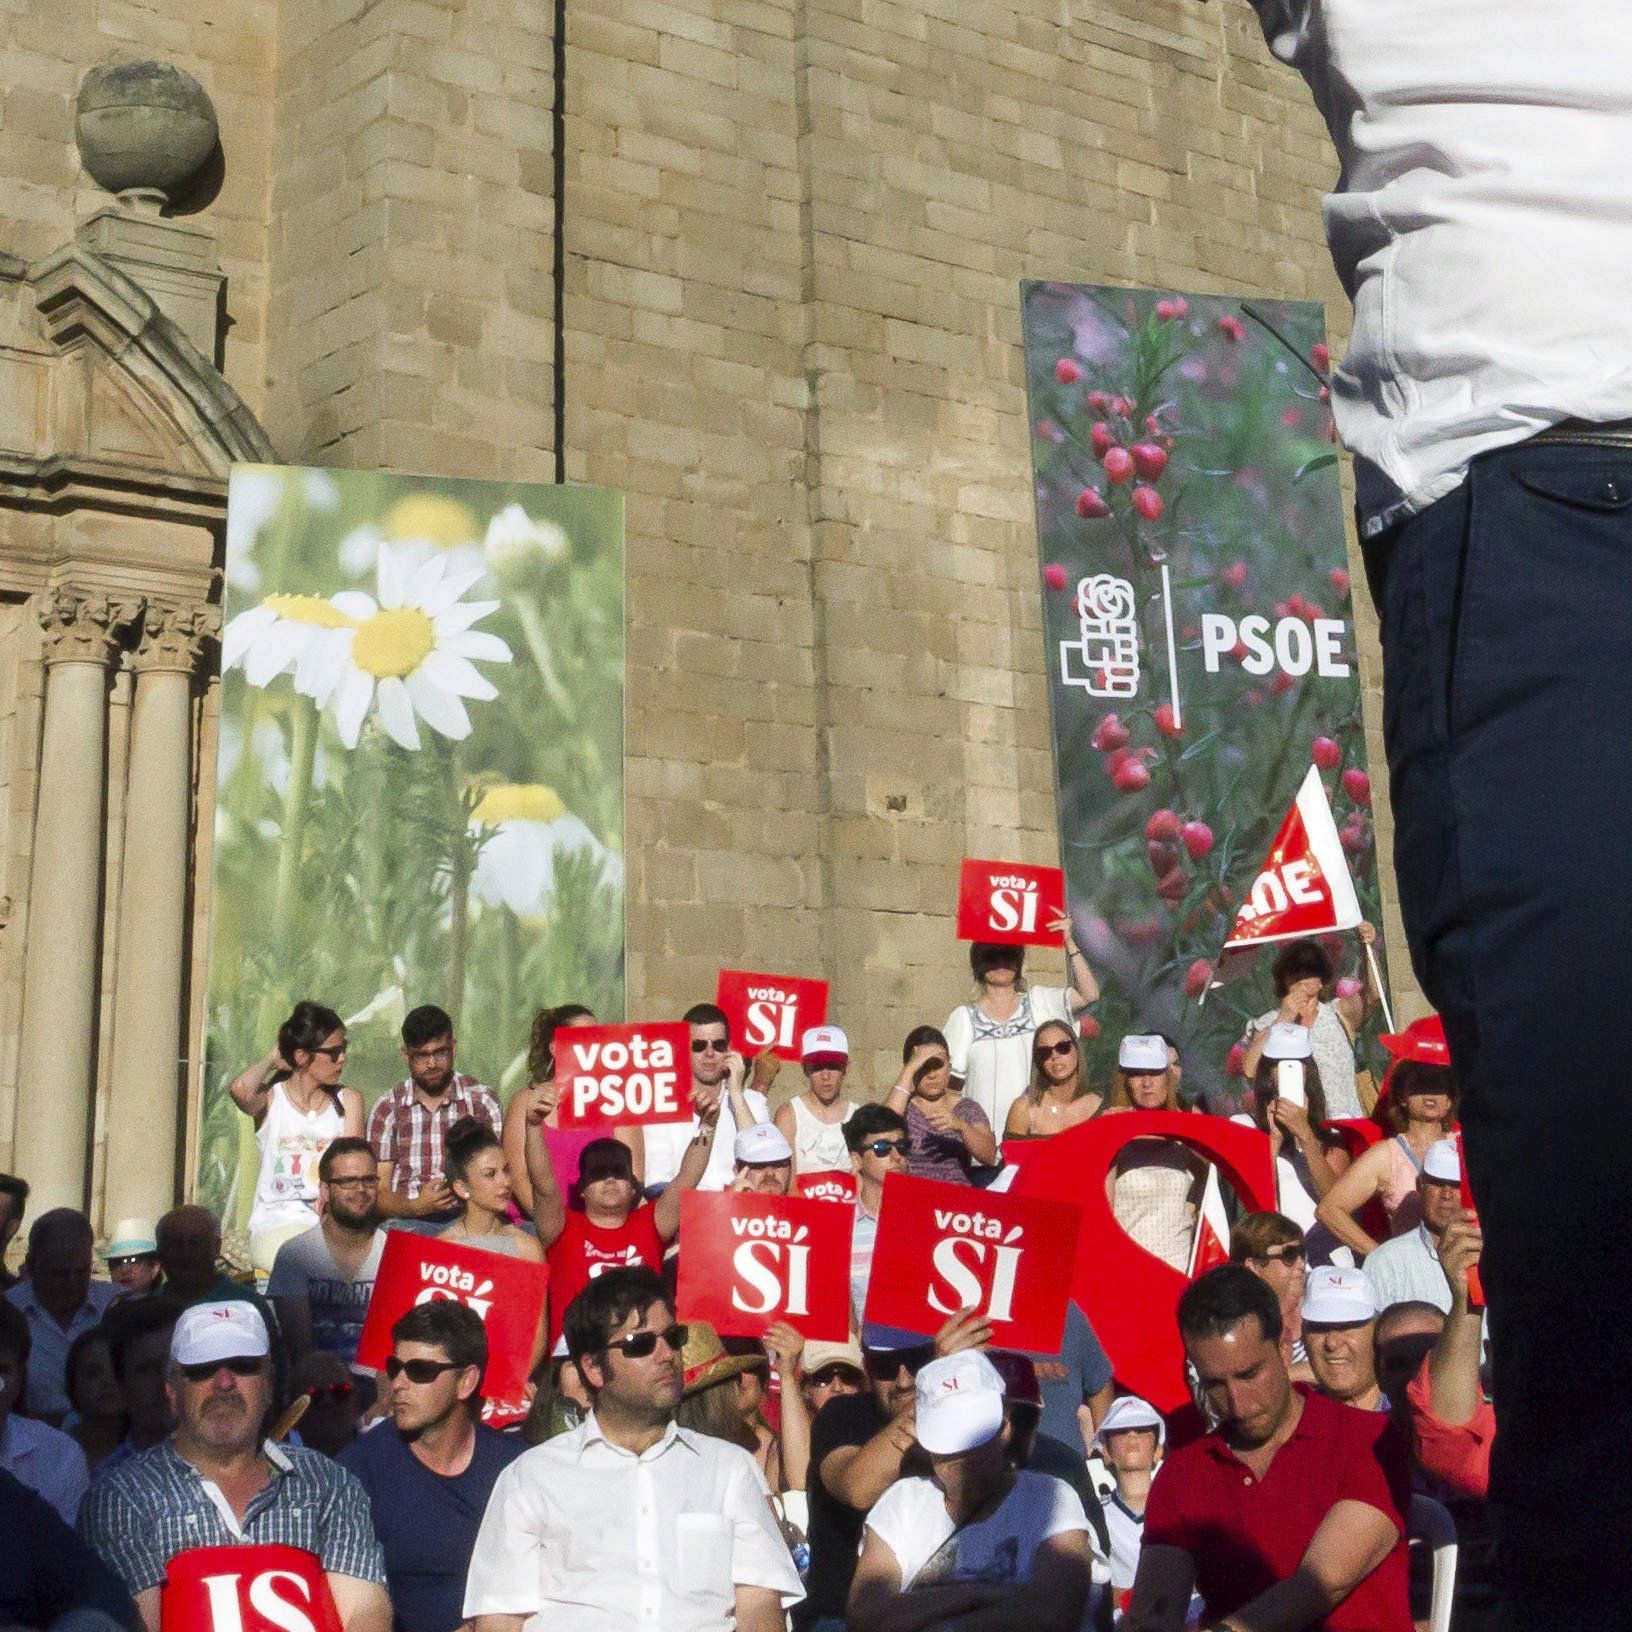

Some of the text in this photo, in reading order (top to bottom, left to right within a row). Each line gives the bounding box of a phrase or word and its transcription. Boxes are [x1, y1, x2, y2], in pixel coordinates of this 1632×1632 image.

[1201, 613, 1351, 679] PSOE
[989, 874, 1026, 890] vota
[989, 882, 1041, 934] SÍ
[747, 988, 785, 1002] vota
[745, 994, 798, 1047] SÍ
[574, 1034, 672, 1070] vota
[573, 1072, 678, 1117] PSOE
[803, 1181, 844, 1199] vota
[731, 1214, 792, 1240] vota
[934, 1208, 1002, 1242] vota
[420, 1261, 475, 1292] vota
[730, 1226, 811, 1316] SÍ
[926, 1226, 1026, 1324] SÍ
